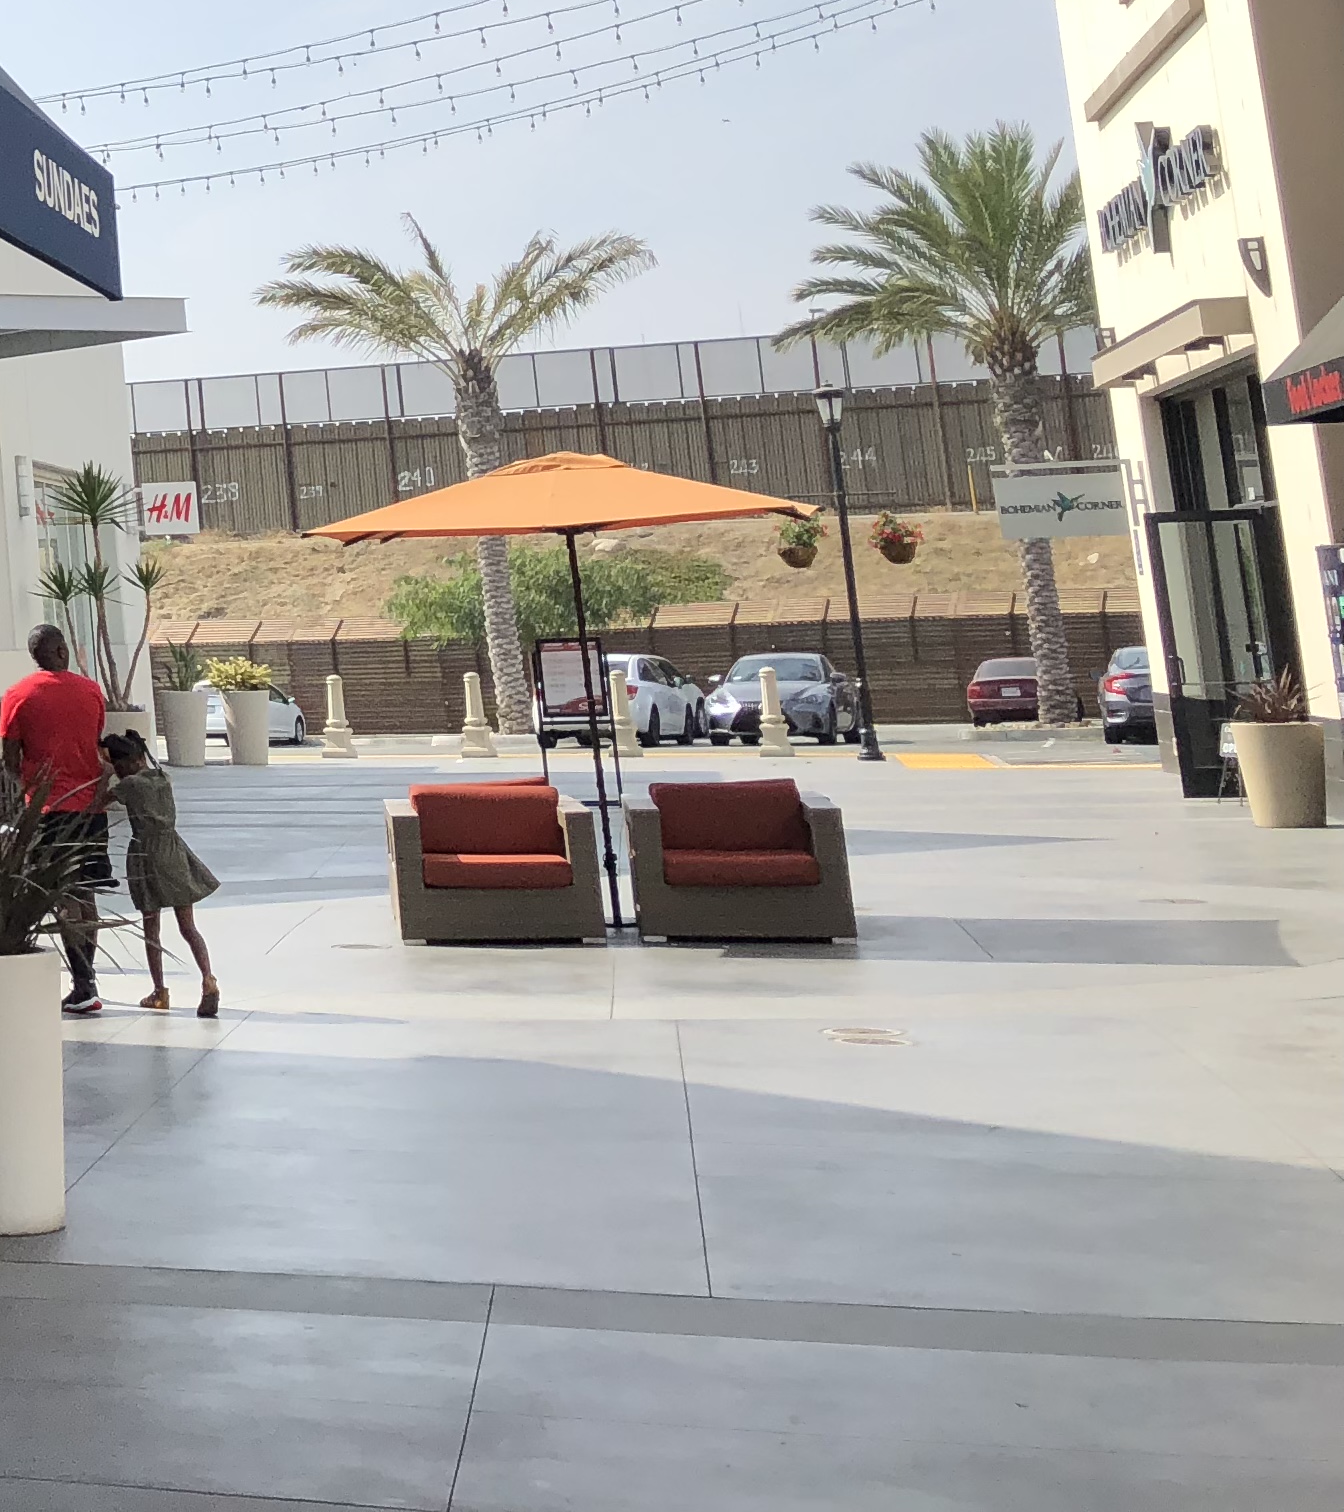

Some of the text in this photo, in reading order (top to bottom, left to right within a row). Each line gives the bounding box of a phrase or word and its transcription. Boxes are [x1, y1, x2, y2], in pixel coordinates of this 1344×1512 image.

[33, 149, 101, 238] SUNDAES
[397, 466, 435, 491] 240
[146, 492, 193, 524] H&M
[1001, 500, 1123, 515] BOHEMIAN CORNER
